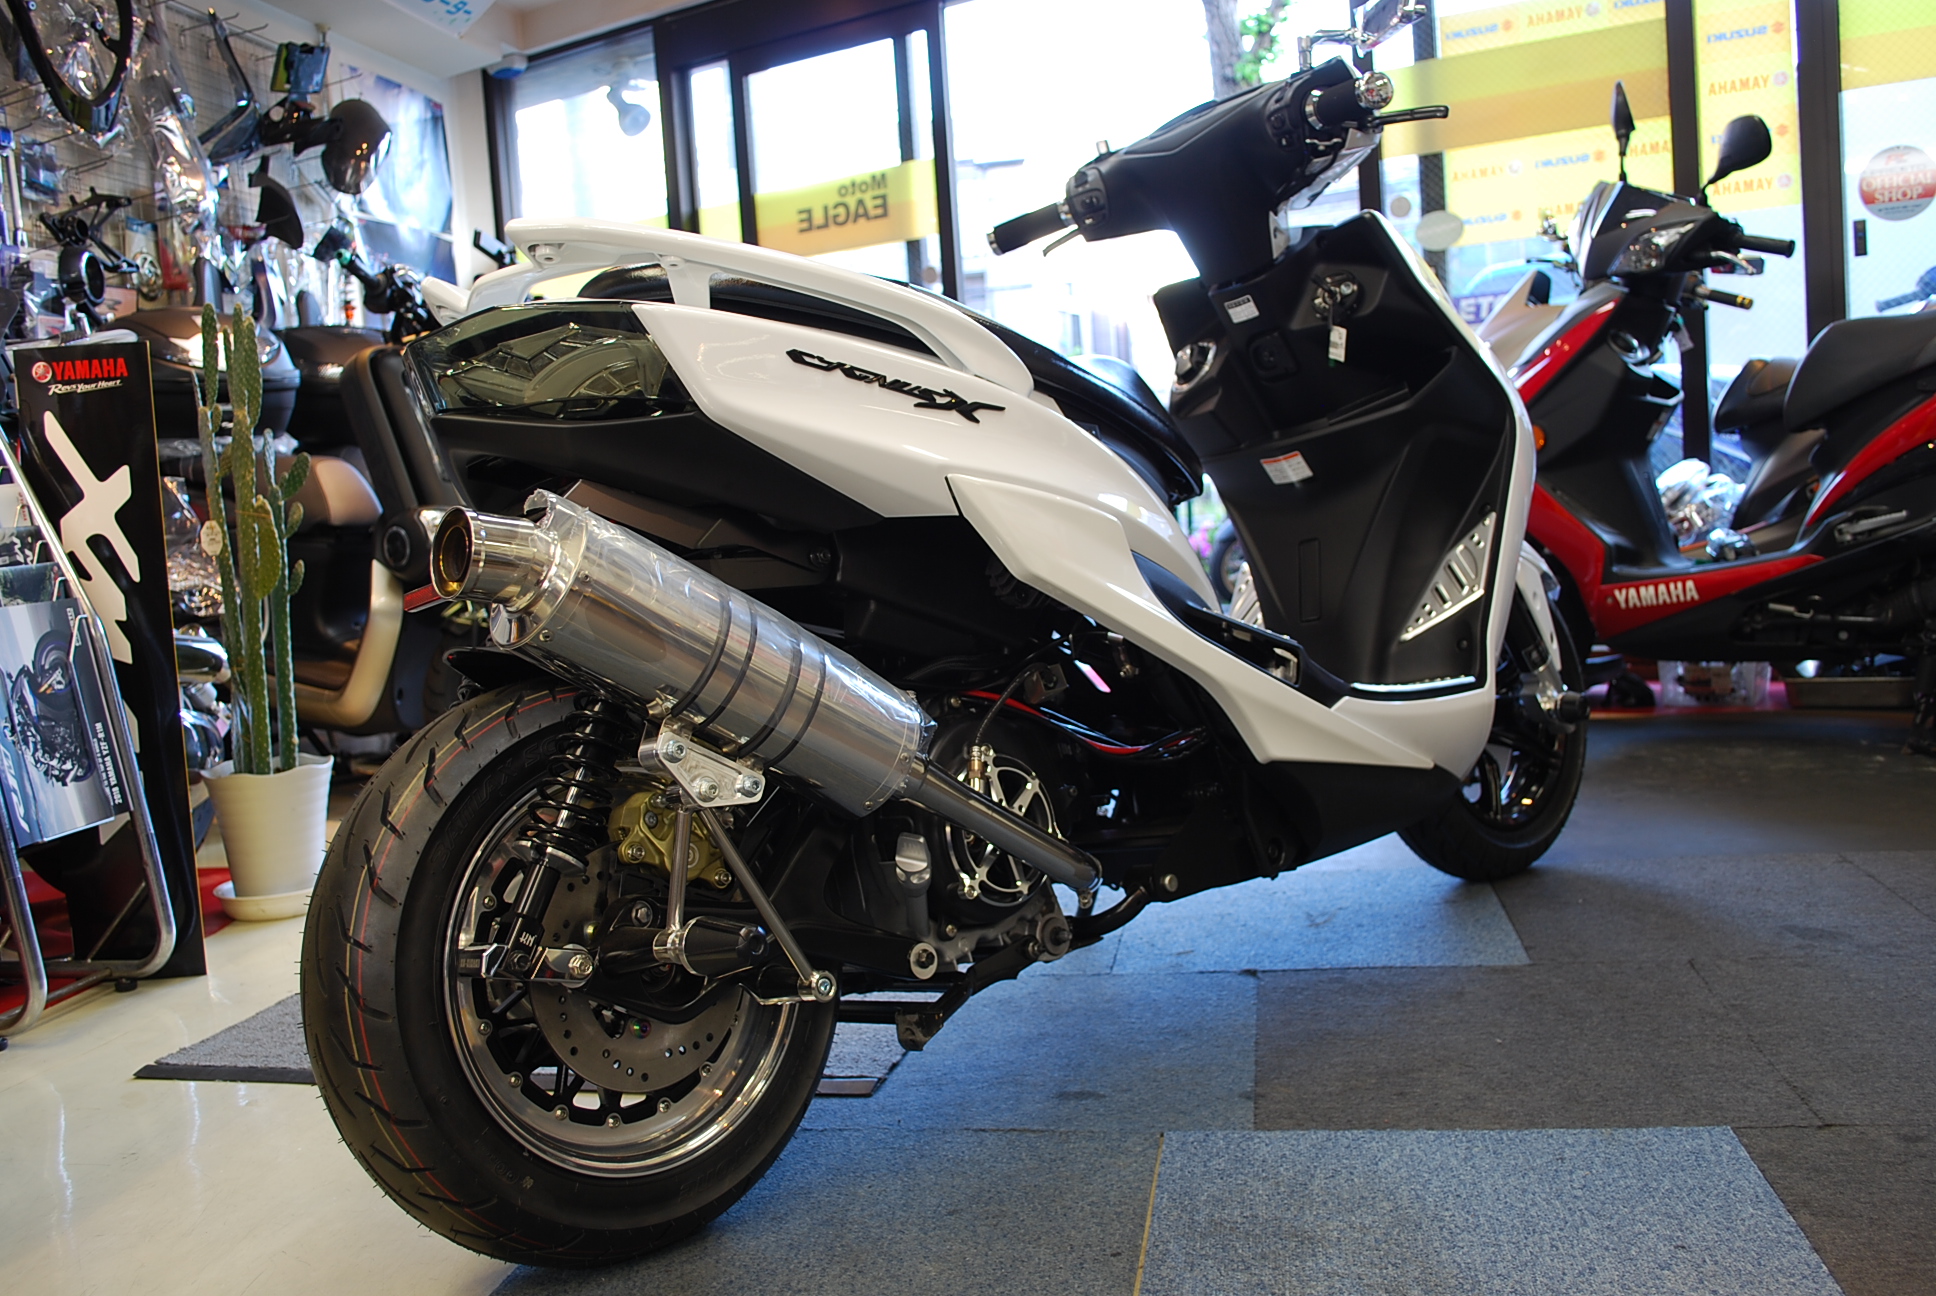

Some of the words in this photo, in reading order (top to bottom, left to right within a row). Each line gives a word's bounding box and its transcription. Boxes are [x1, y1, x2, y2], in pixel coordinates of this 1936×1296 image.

[1874, 186, 1923, 204] SHOP
[51, 357, 128, 381] YAMAHA
[1613, 579, 1699, 610] YAMAHA
[103, 755, 118, 786] YAMAHA
